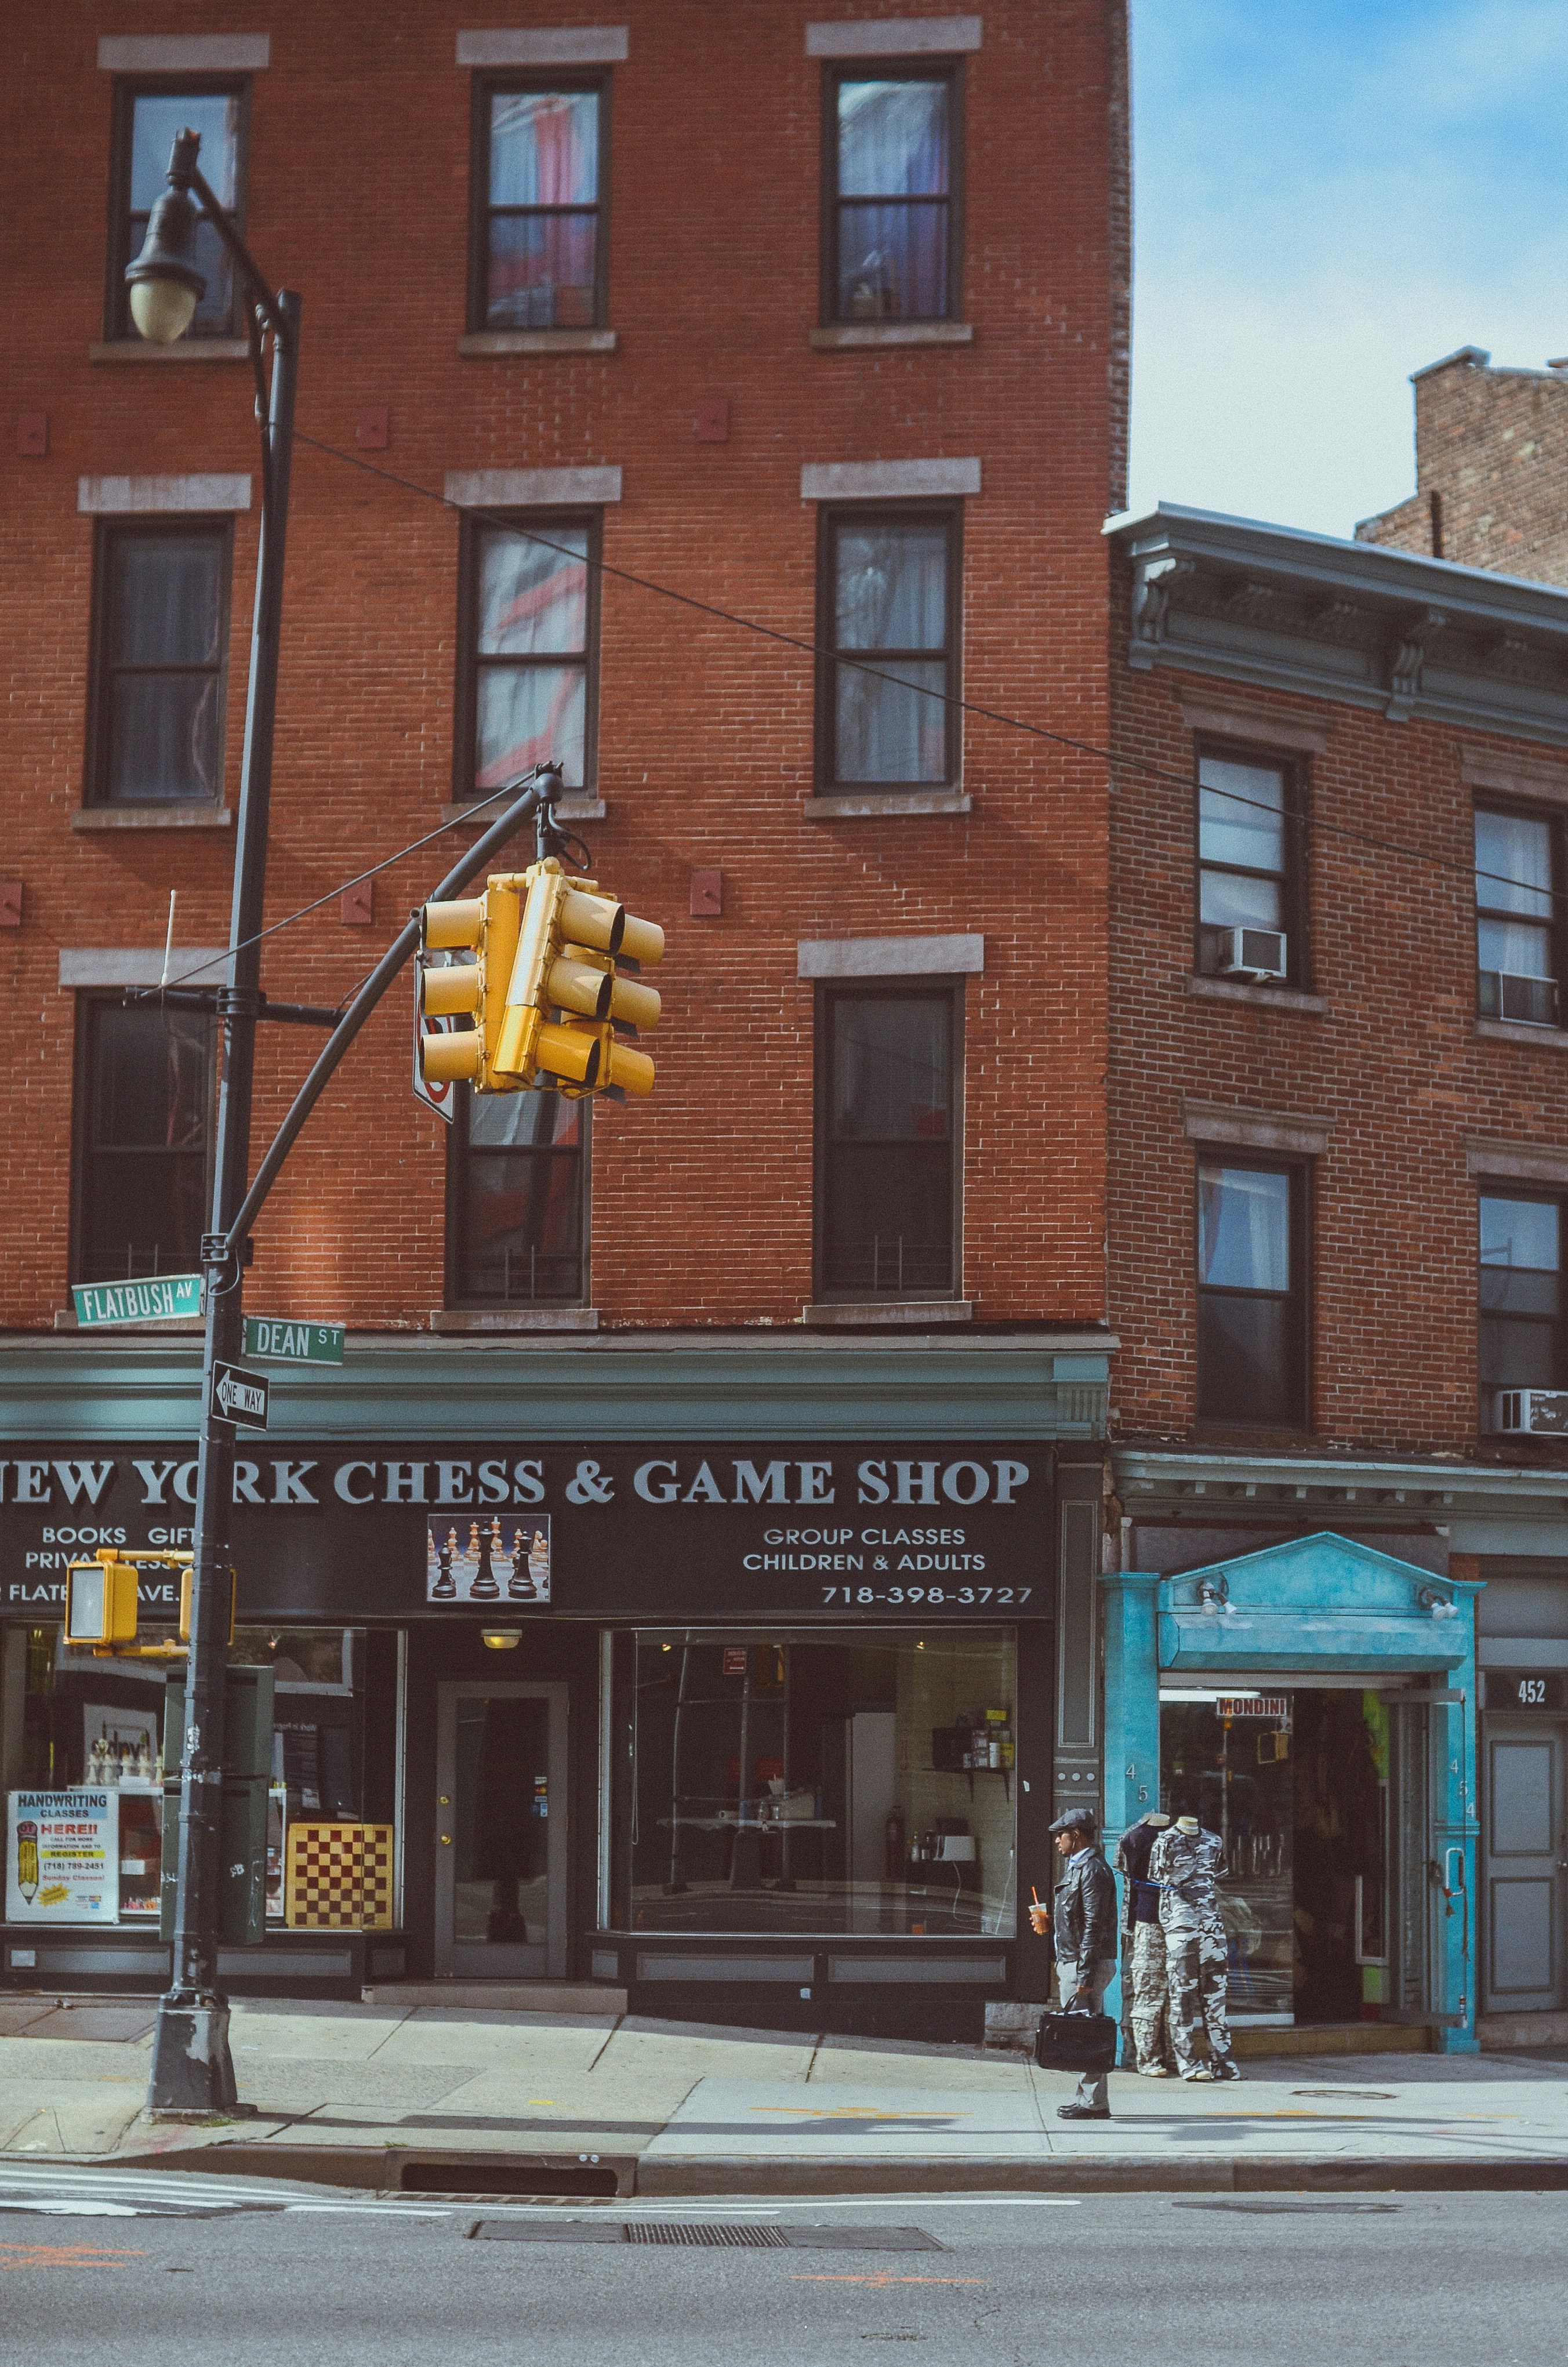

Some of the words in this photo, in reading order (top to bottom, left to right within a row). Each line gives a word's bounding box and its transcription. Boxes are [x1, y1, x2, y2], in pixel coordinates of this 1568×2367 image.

[83, 1283, 173, 1320] FLATBUSH
[176, 1281, 192, 1298] AV
[257, 1323, 309, 1356] DEAN
[318, 1328, 340, 1345] ST
[222, 1382, 237, 1405] ONE
[244, 1388, 261, 1411] WAY
[335, 1460, 545, 1504] CHESS
[566, 1460, 614, 1504] &
[634, 1460, 835, 1504] GAME
[858, 1460, 1029, 1505] SHOP
[43, 1527, 126, 1544] BOOKS
[764, 1529, 853, 1545] GROUP
[861, 1528, 965, 1545] CLASSES
[743, 1554, 863, 1570] CHILDREN
[873, 1555, 889, 1571] &
[897, 1554, 985, 1571] ADULTS
[822, 1587, 1032, 1604] 718-398-3727
[1519, 1680, 1545, 1703] 452
[1219, 1698, 1286, 1715] MONDINI
[18, 1794, 107, 1808] HANDWRITING
[40, 1809, 89, 1818] CLASSES
[43, 1862, 65, 1871] (718)
